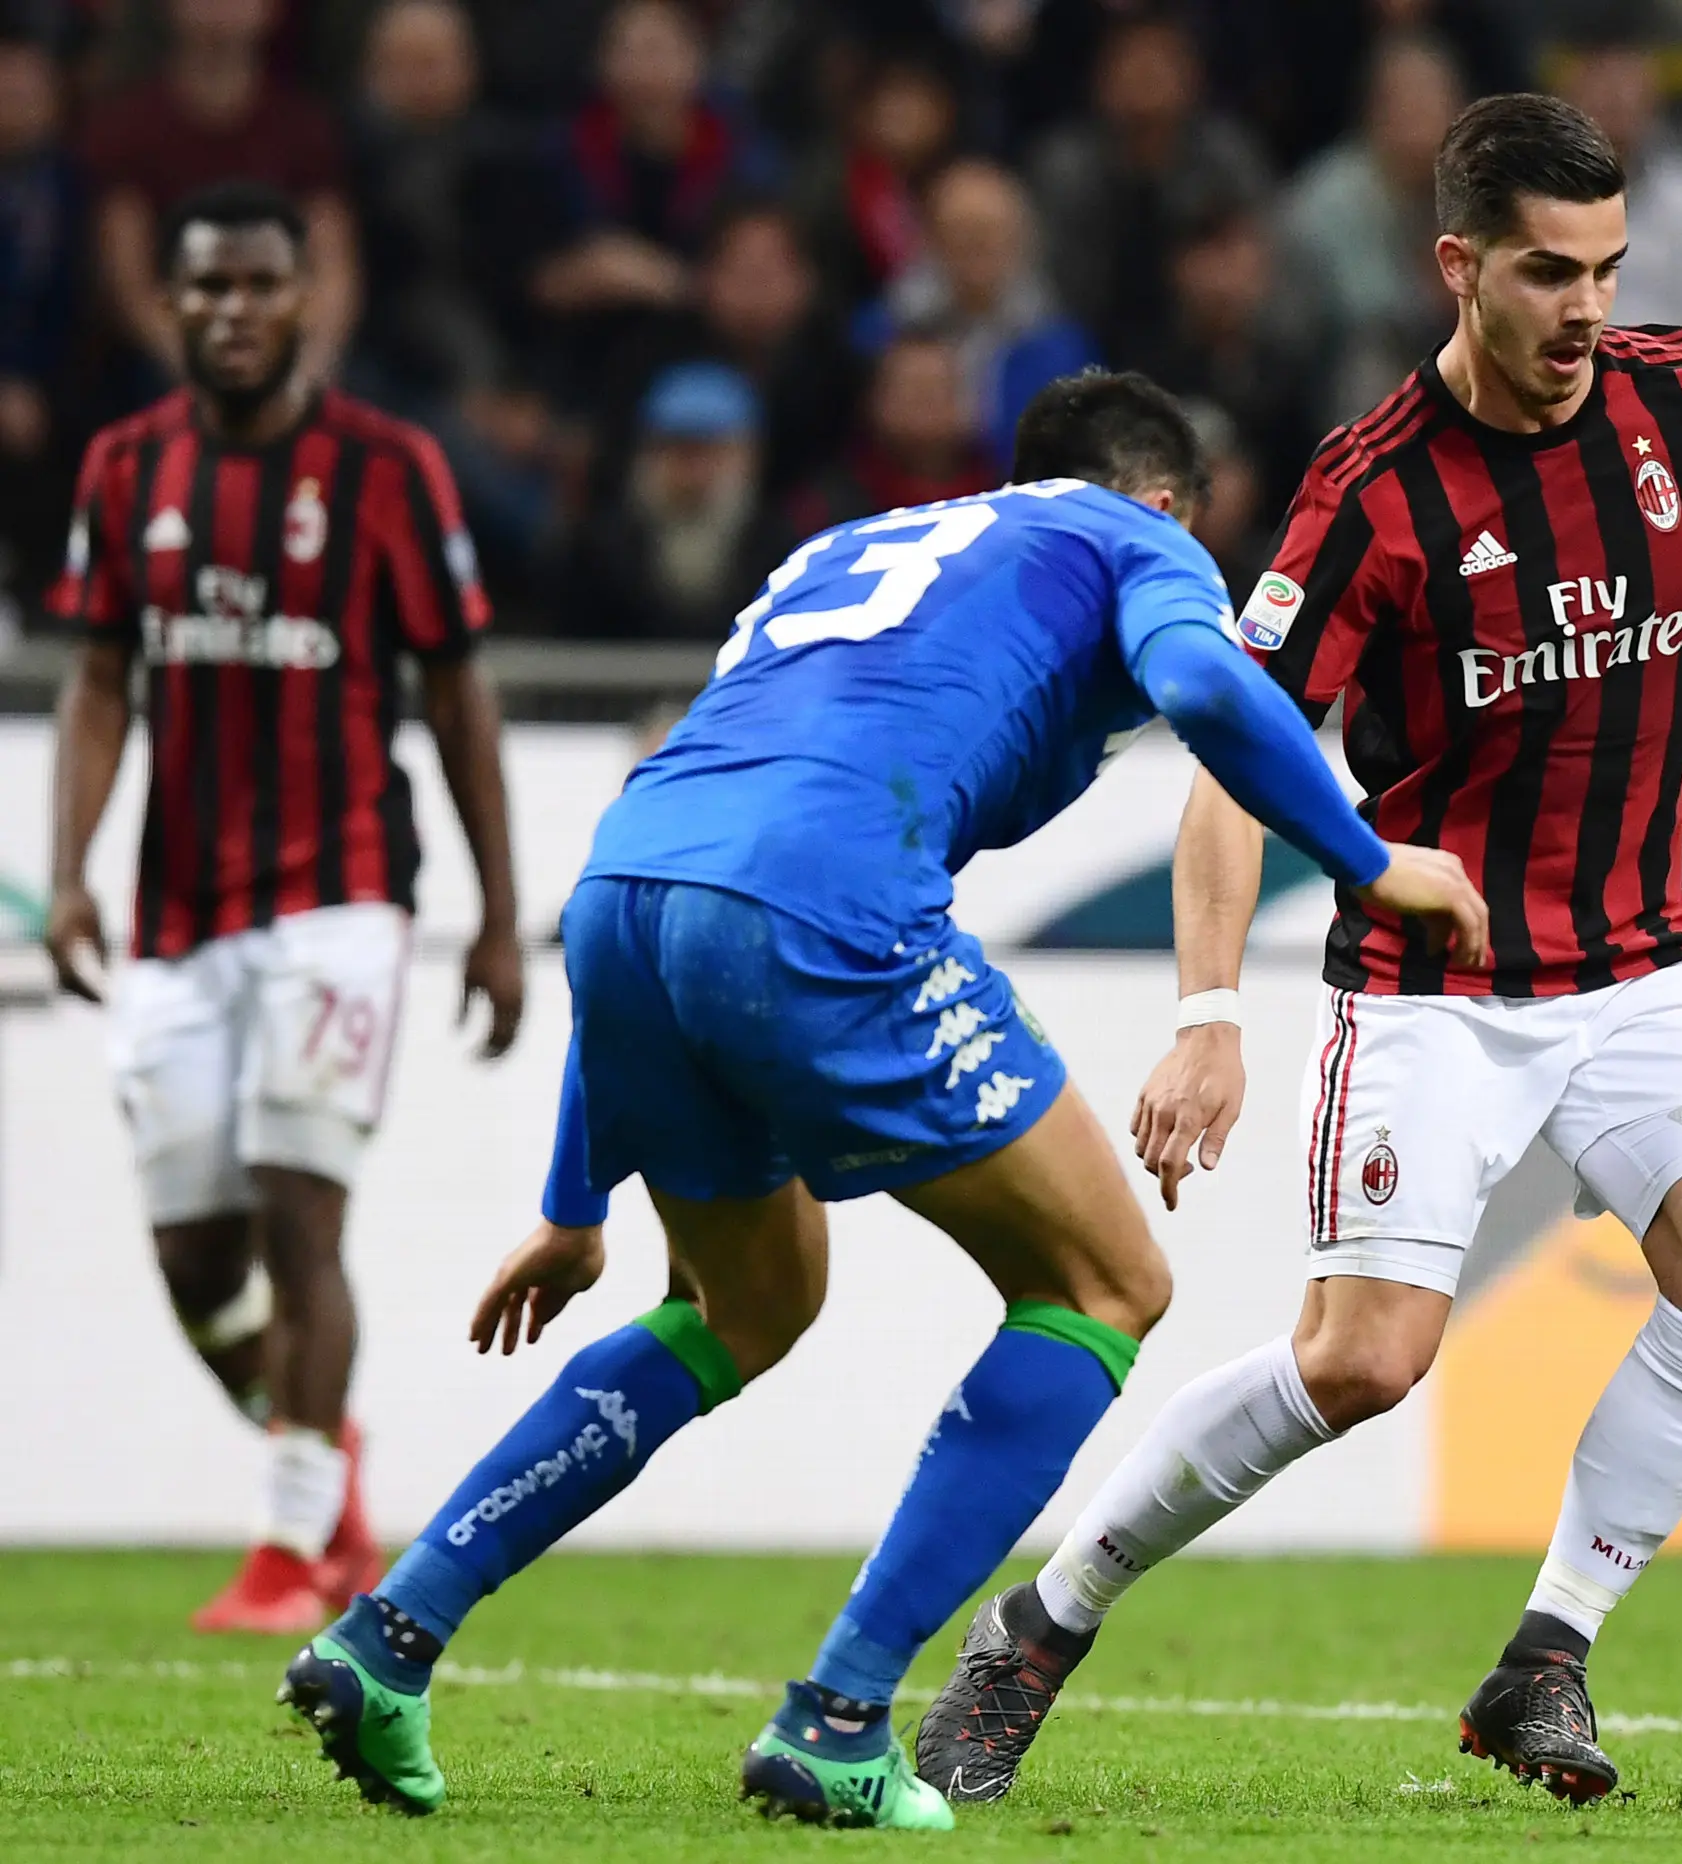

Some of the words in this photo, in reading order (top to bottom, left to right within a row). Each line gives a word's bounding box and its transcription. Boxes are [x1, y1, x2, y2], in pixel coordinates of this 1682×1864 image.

[1459, 552, 1518, 576] adidas
[716, 503, 998, 678] 13
[1547, 576, 1627, 626] Fly
[1255, 626, 1276, 645] TIM
[300, 981, 377, 1079] 79
